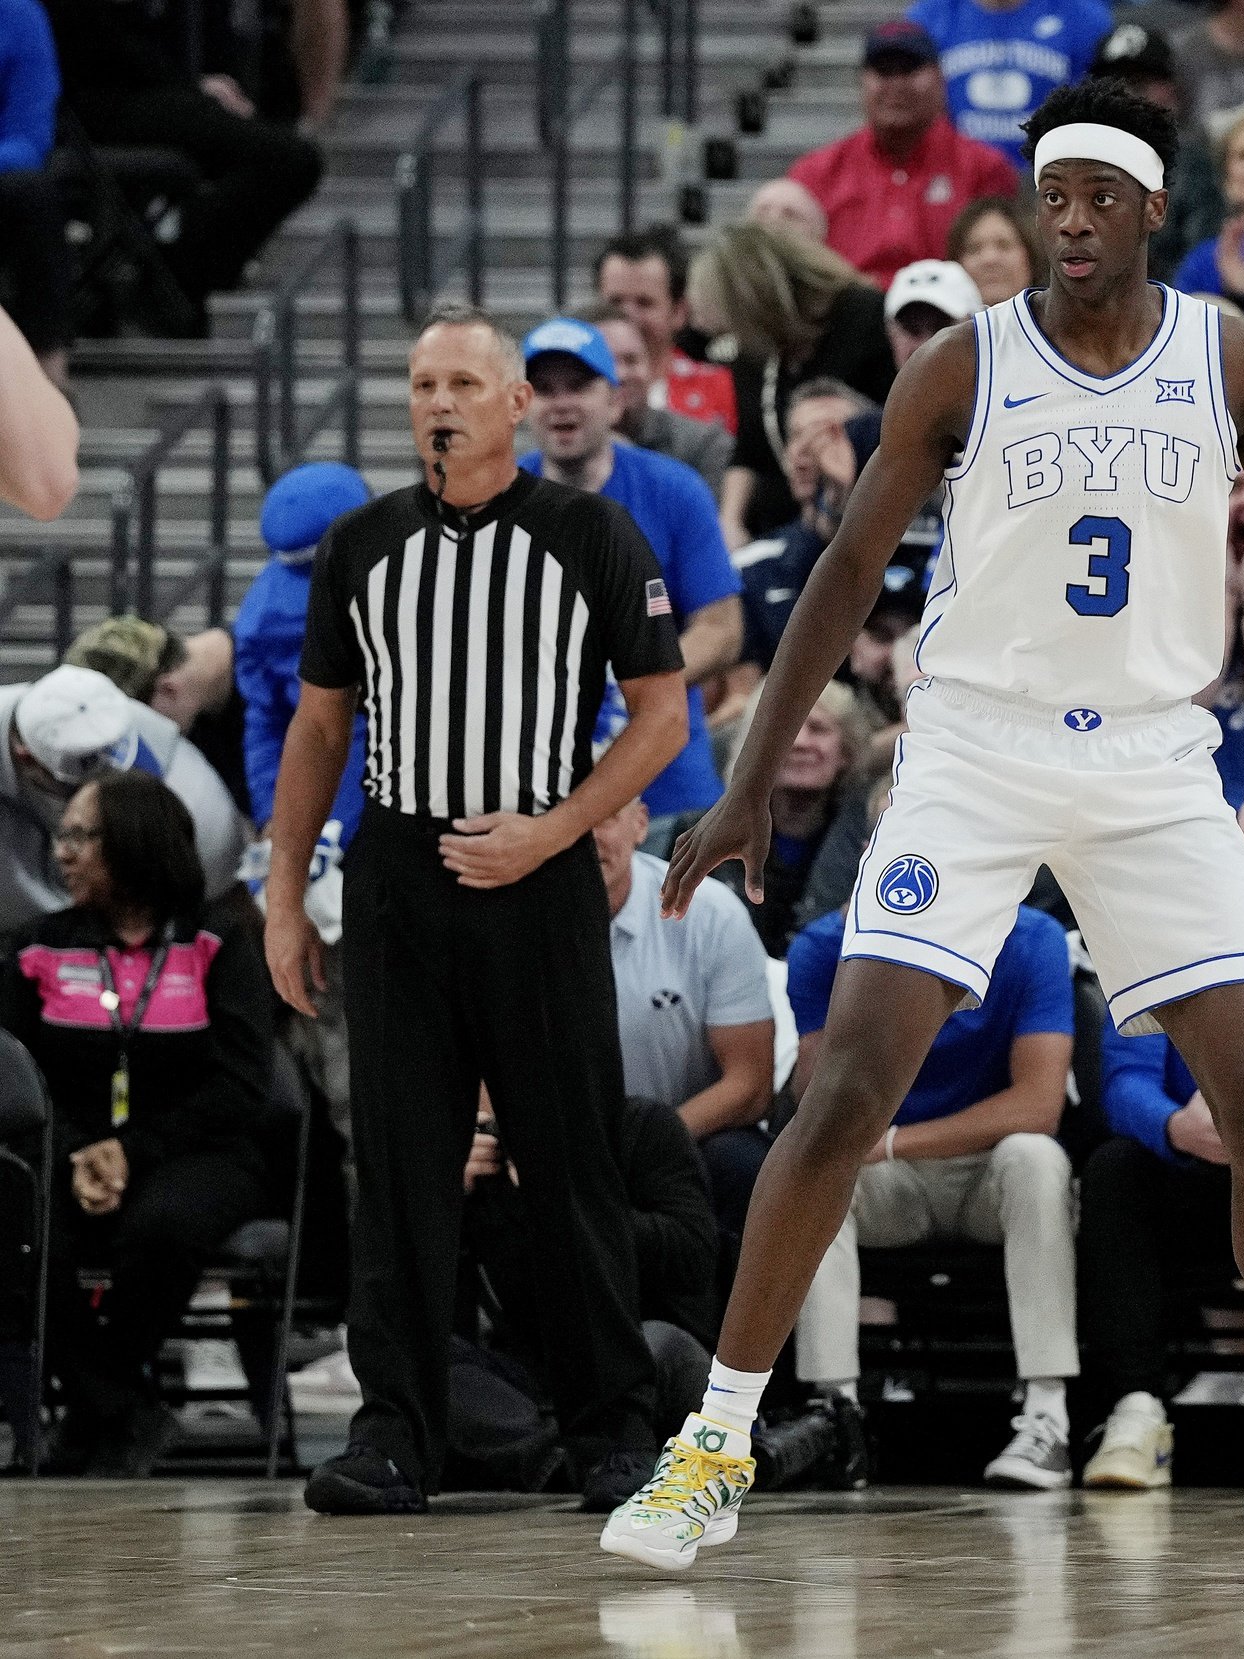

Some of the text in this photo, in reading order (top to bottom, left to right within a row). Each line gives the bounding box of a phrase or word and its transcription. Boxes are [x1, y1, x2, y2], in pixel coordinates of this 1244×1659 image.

[1003, 426, 1201, 509] BYU
[1066, 515, 1132, 617] 3
[1070, 710, 1097, 730] Y
[894, 889, 913, 904] Y
